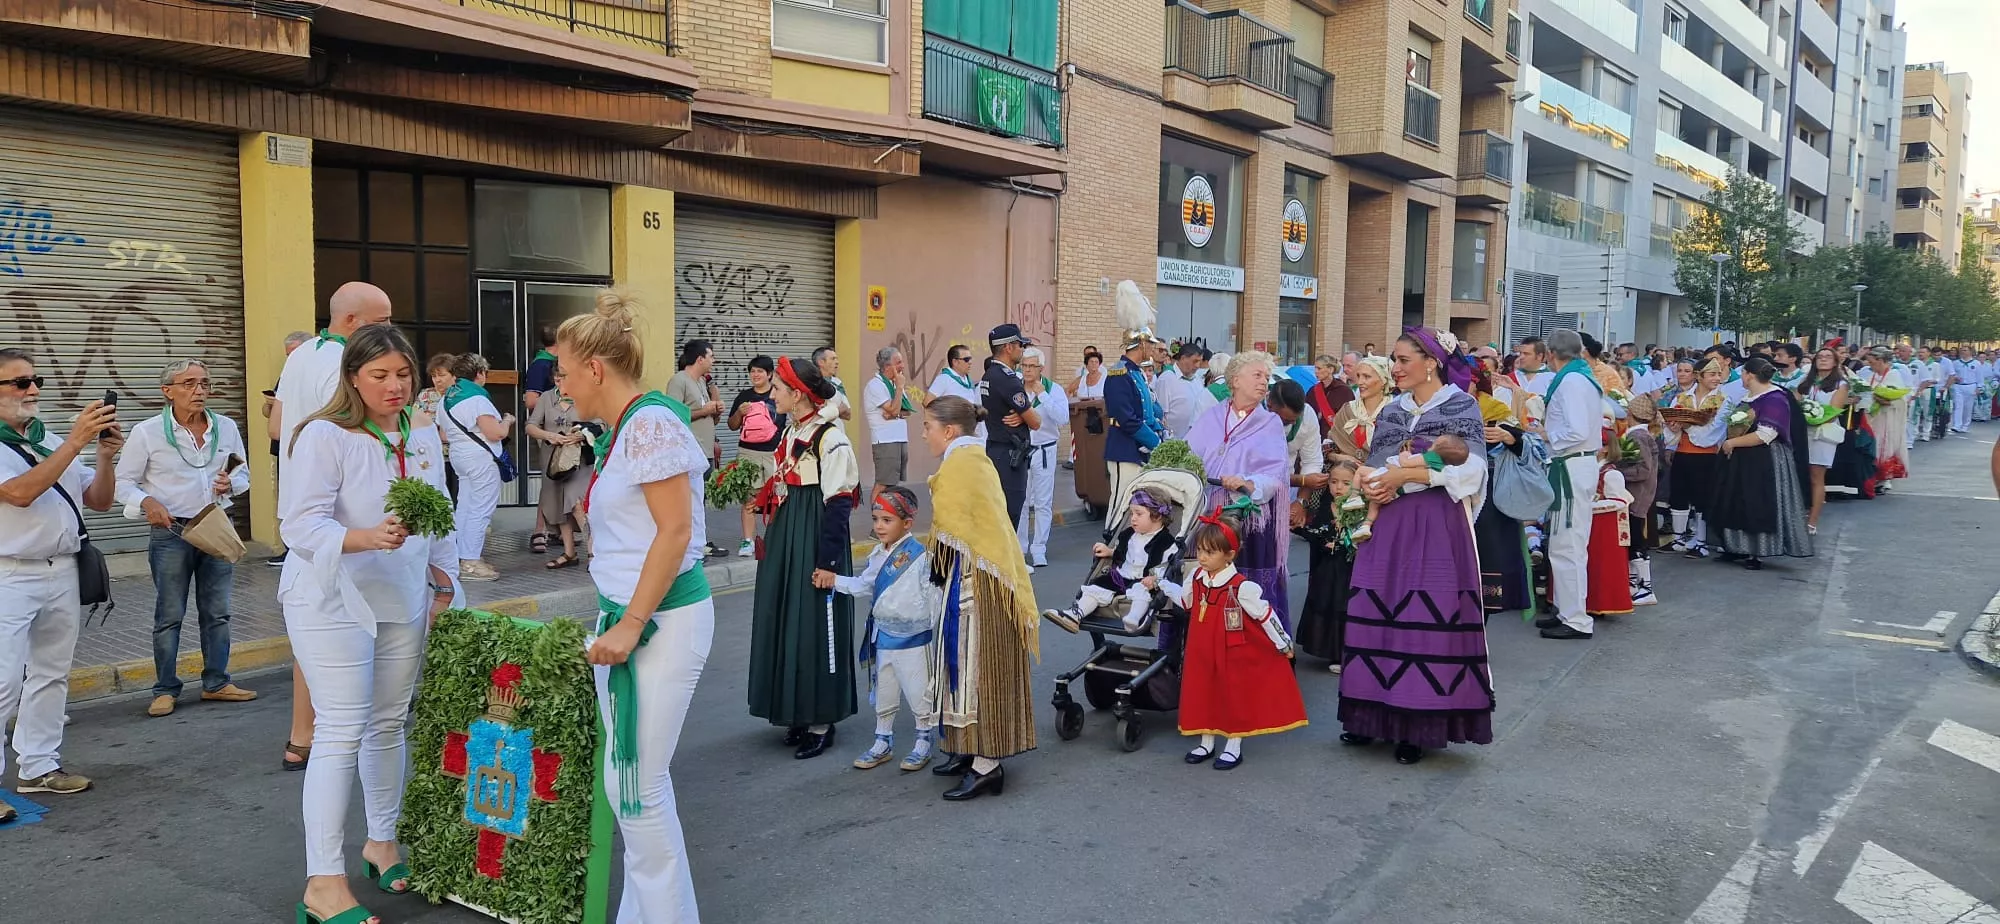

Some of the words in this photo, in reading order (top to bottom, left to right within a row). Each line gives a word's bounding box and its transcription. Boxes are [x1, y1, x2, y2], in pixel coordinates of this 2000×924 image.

[643, 210, 661, 230] 65
[1163, 271, 1200, 284] GANADEROS
[1200, 275, 1208, 285] DE
[1181, 263, 1189, 273] DE
[1190, 265, 1231, 278] AGRICULTORES
[1231, 270, 1235, 279] Y
